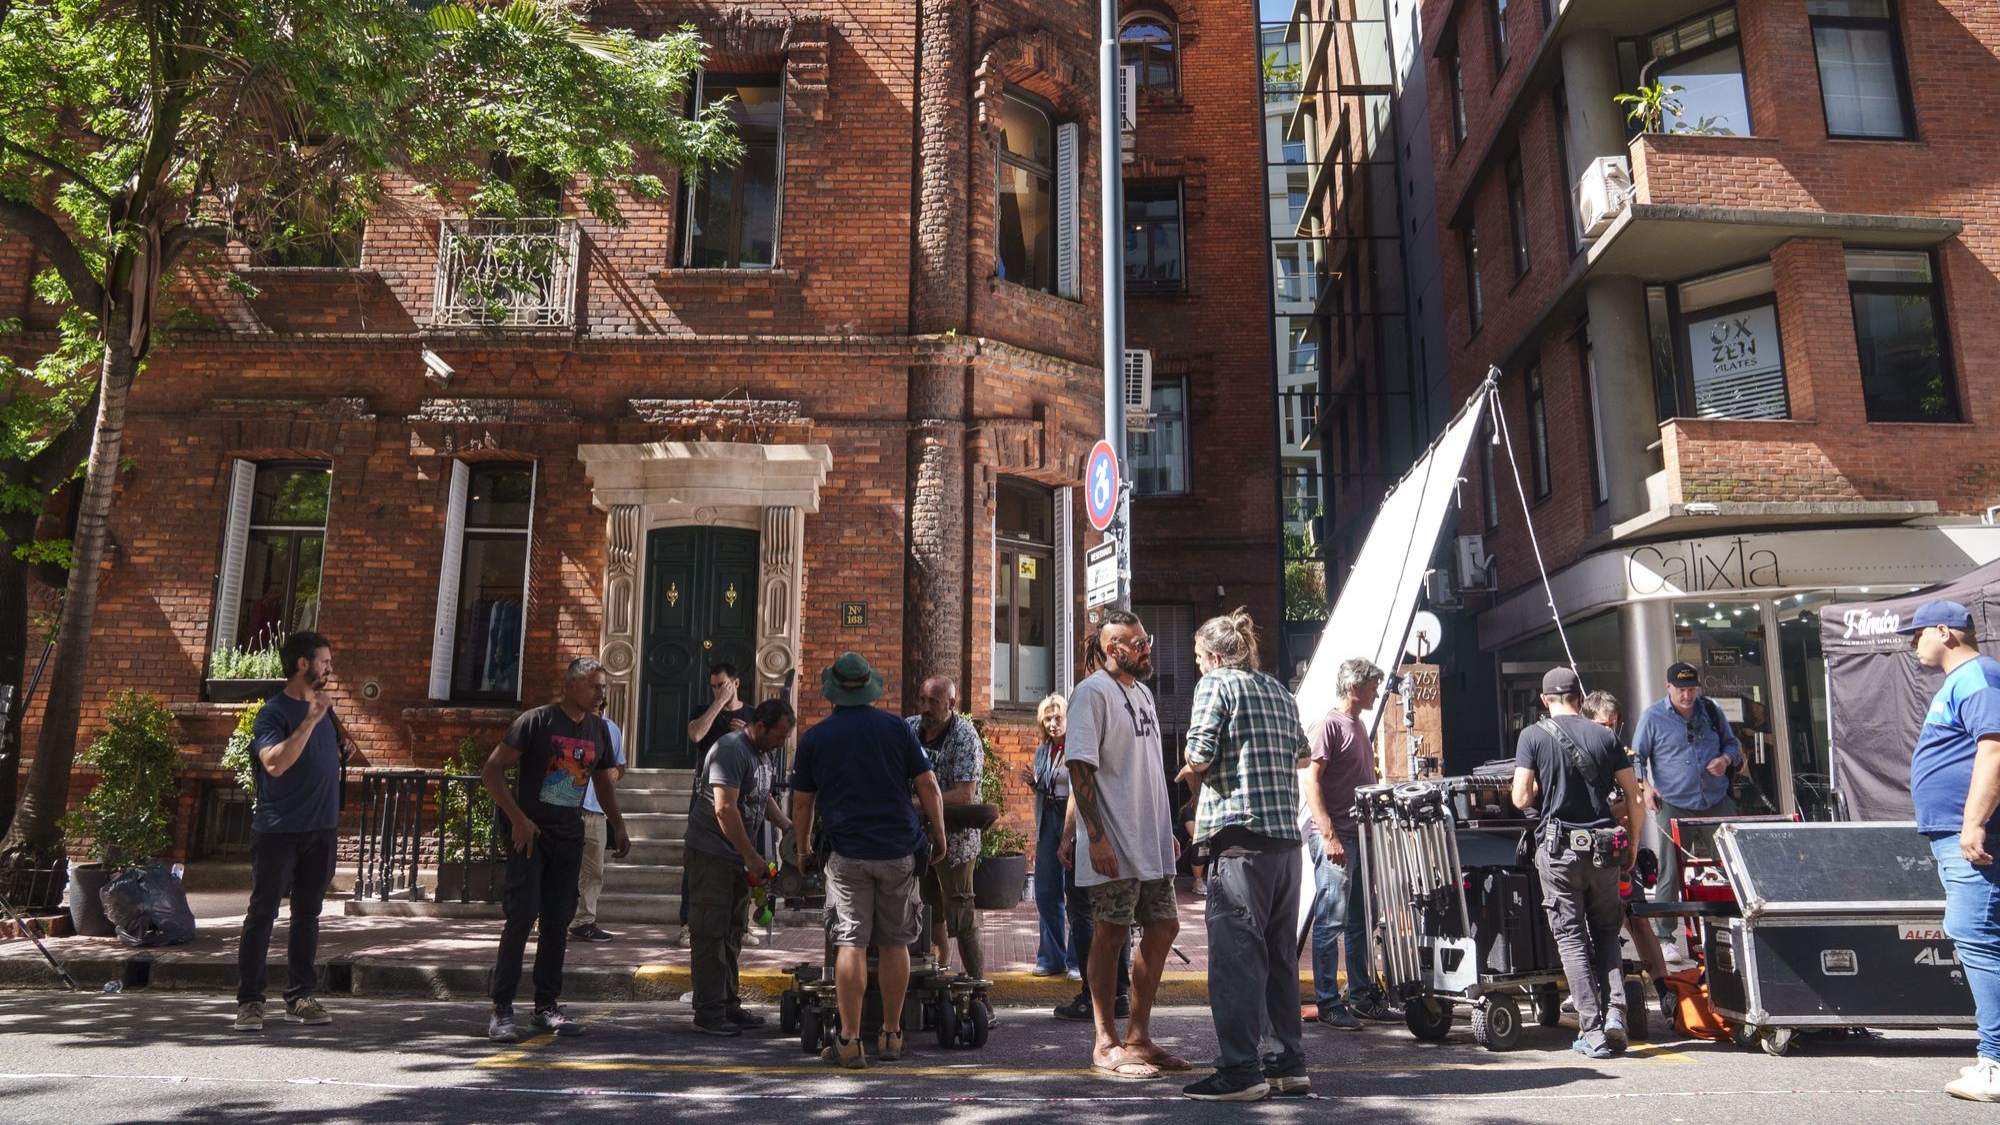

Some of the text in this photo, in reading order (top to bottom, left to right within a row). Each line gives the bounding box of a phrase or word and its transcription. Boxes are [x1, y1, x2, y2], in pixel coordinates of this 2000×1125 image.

[1710, 315, 1752, 344] OX
[1712, 338, 1755, 363] ZEN
[1713, 358, 1758, 373] PILATES
[1629, 537, 1786, 595] Calixta
[1877, 637, 1902, 645] SUPPLIES
[1905, 930, 1942, 939] ALFA
